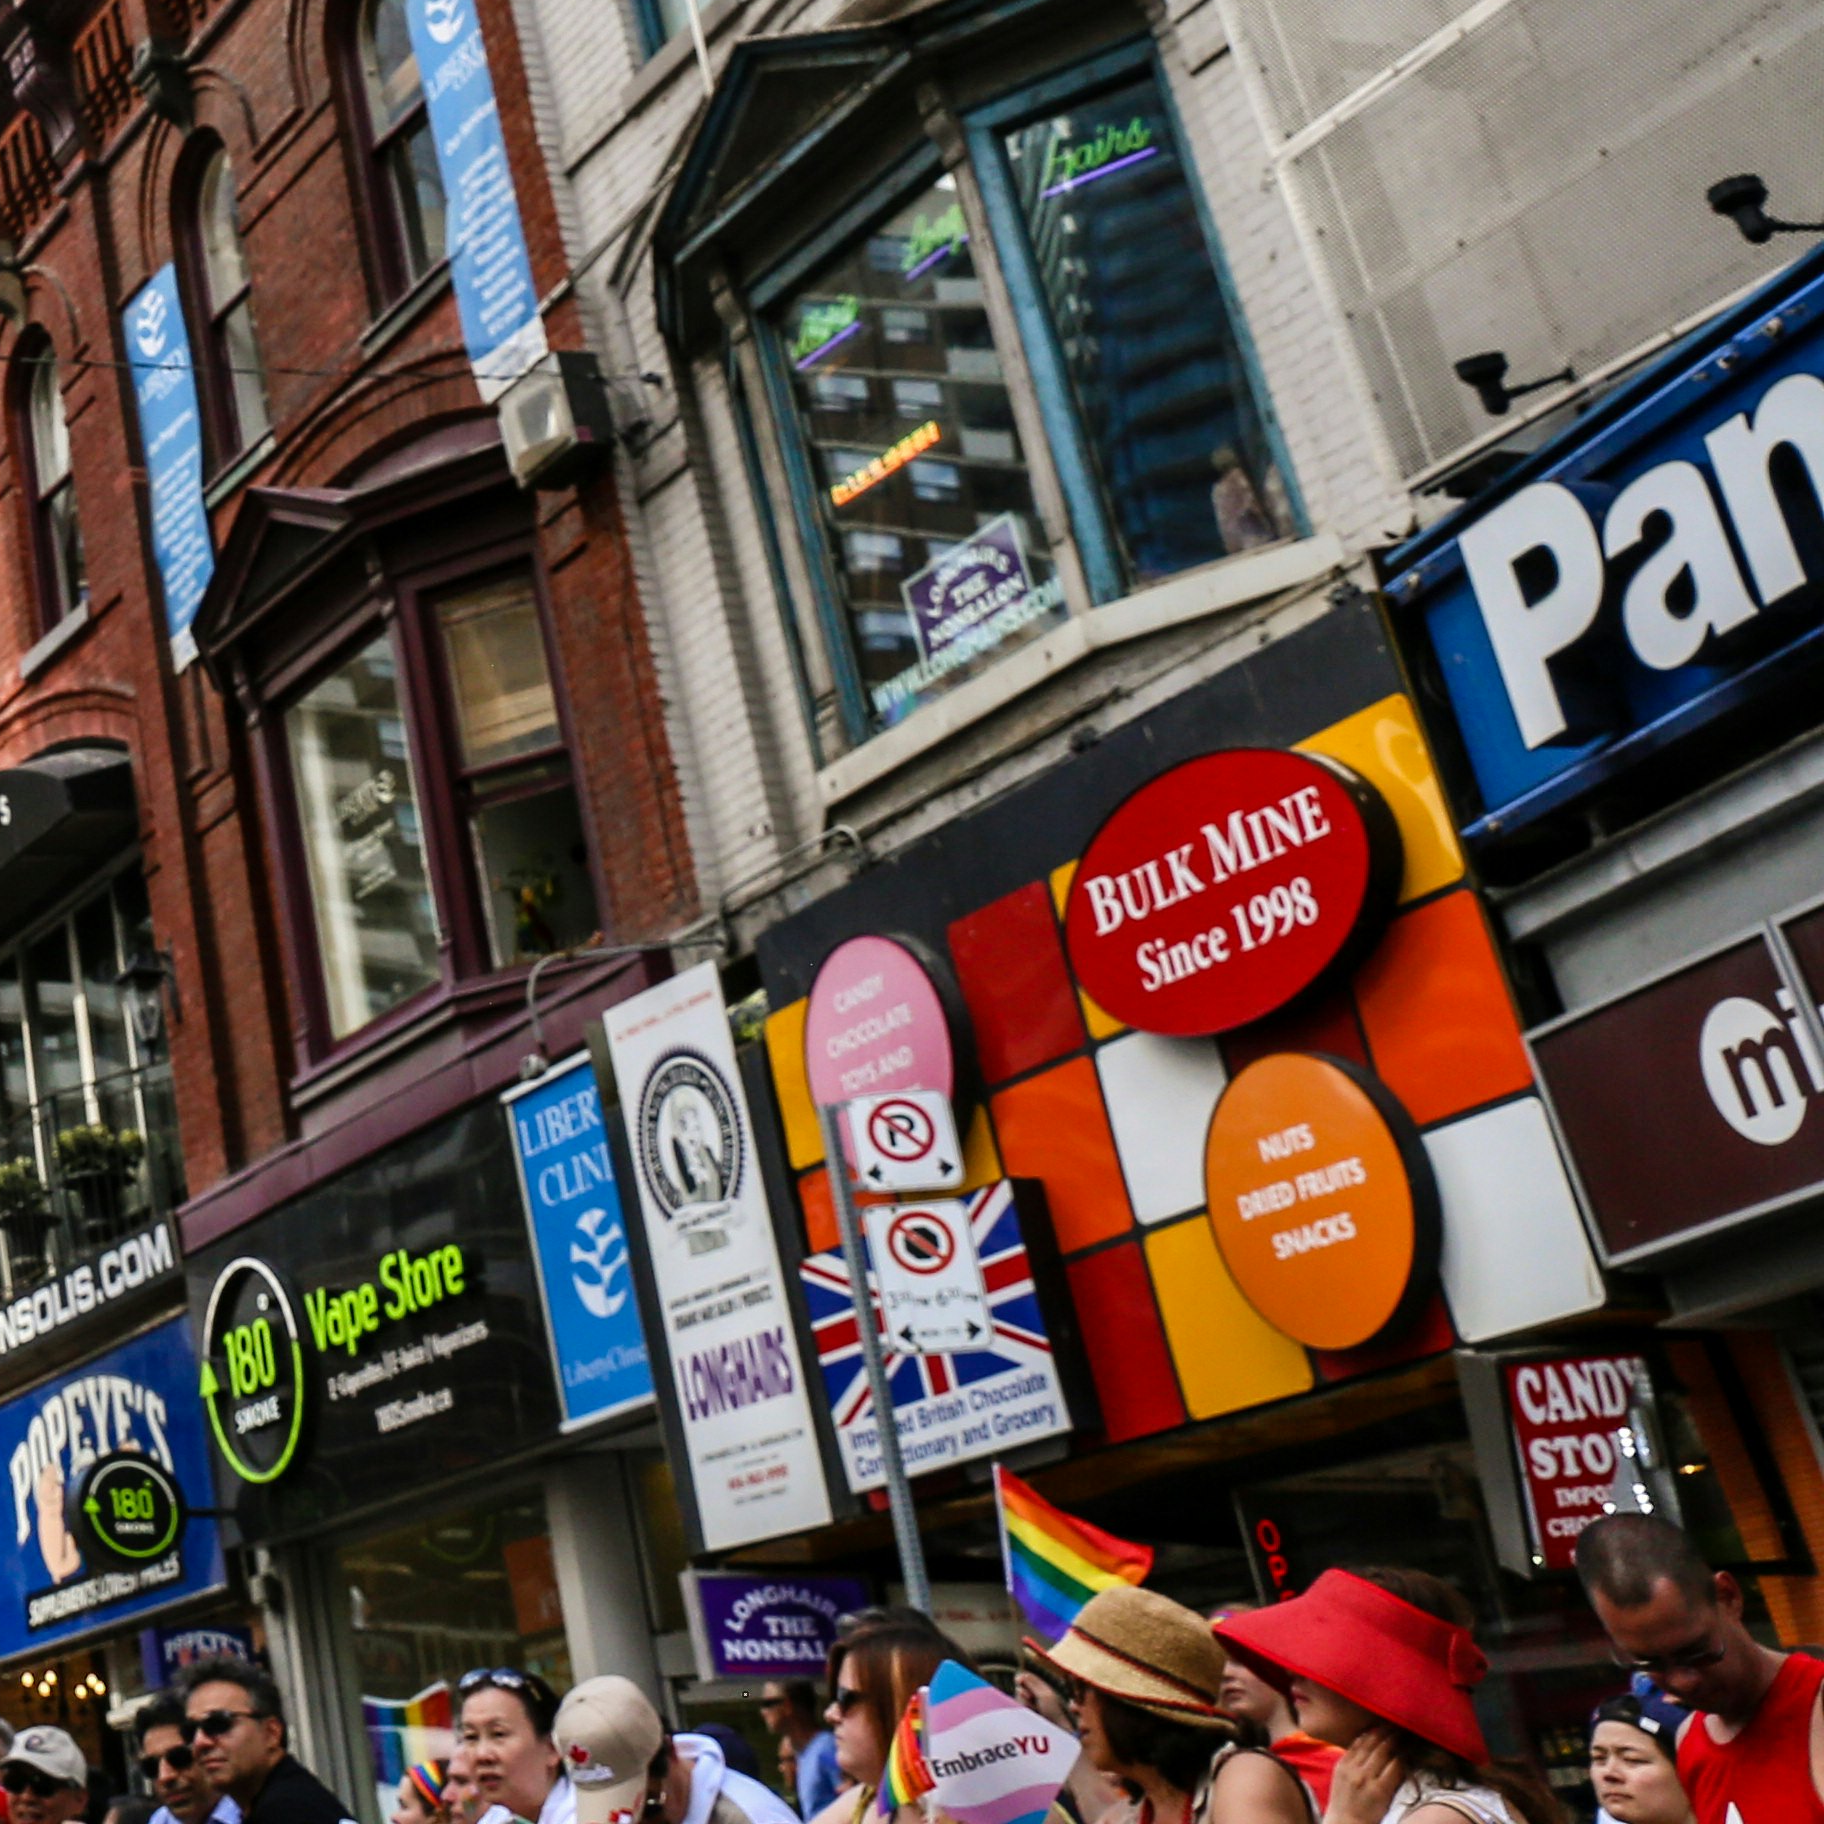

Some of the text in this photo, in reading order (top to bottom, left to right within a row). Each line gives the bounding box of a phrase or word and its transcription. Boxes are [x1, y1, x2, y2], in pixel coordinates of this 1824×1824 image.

[1083, 784, 1332, 937] BULK MINE
[1136, 875, 1321, 993] Since 1998
[832, 972, 886, 1015] CANDY
[825, 1002, 913, 1060] CHOCOLATE
[1256, 1122, 1316, 1164] NUTS
[1236, 1155, 1368, 1222] DRIED FRUITS
[1270, 1210, 1358, 1261] SNACKS
[303, 1244, 467, 1357] Vape Store
[916, 1397, 965, 1430] British
[968, 1371, 1050, 1411] Chocolate
[962, 1423, 991, 1447] and
[990, 1403, 1058, 1438] Grocery
[762, 1614, 820, 1637] THE
